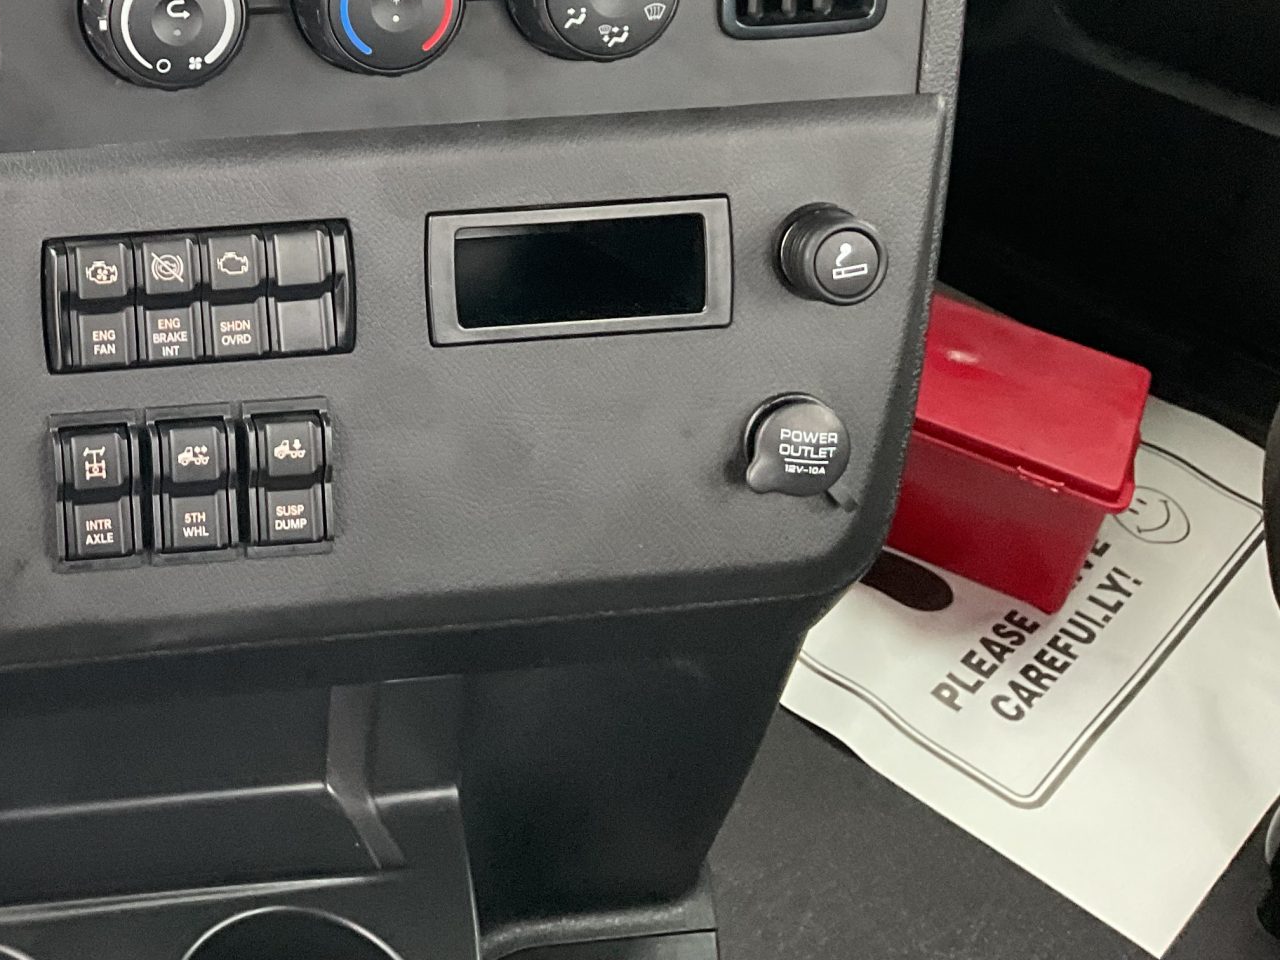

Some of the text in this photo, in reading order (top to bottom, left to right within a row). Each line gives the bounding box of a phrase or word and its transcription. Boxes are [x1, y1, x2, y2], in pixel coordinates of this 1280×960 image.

[157, 317, 181, 330] ENG
[220, 319, 251, 333] SHDN
[92, 329, 116, 342] ENG
[152, 331, 188, 344] BRAKE
[221, 333, 252, 346] OVRD
[93, 343, 116, 355] FAN
[161, 345, 180, 357] INT
[780, 428, 838, 444] POWER
[779, 443, 837, 458] OUTLET
[784, 463, 826, 475] 12V-10A
[275, 504, 305, 517] SUSP
[184, 511, 206, 524] 5TH
[274, 517, 308, 531] DUMP
[85, 519, 112, 532] INTR
[183, 525, 210, 538] WHL
[85, 532, 114, 546] AXLE
[990, 566, 1143, 721] CAREFULLY!
[930, 608, 1041, 713] PLEASE
